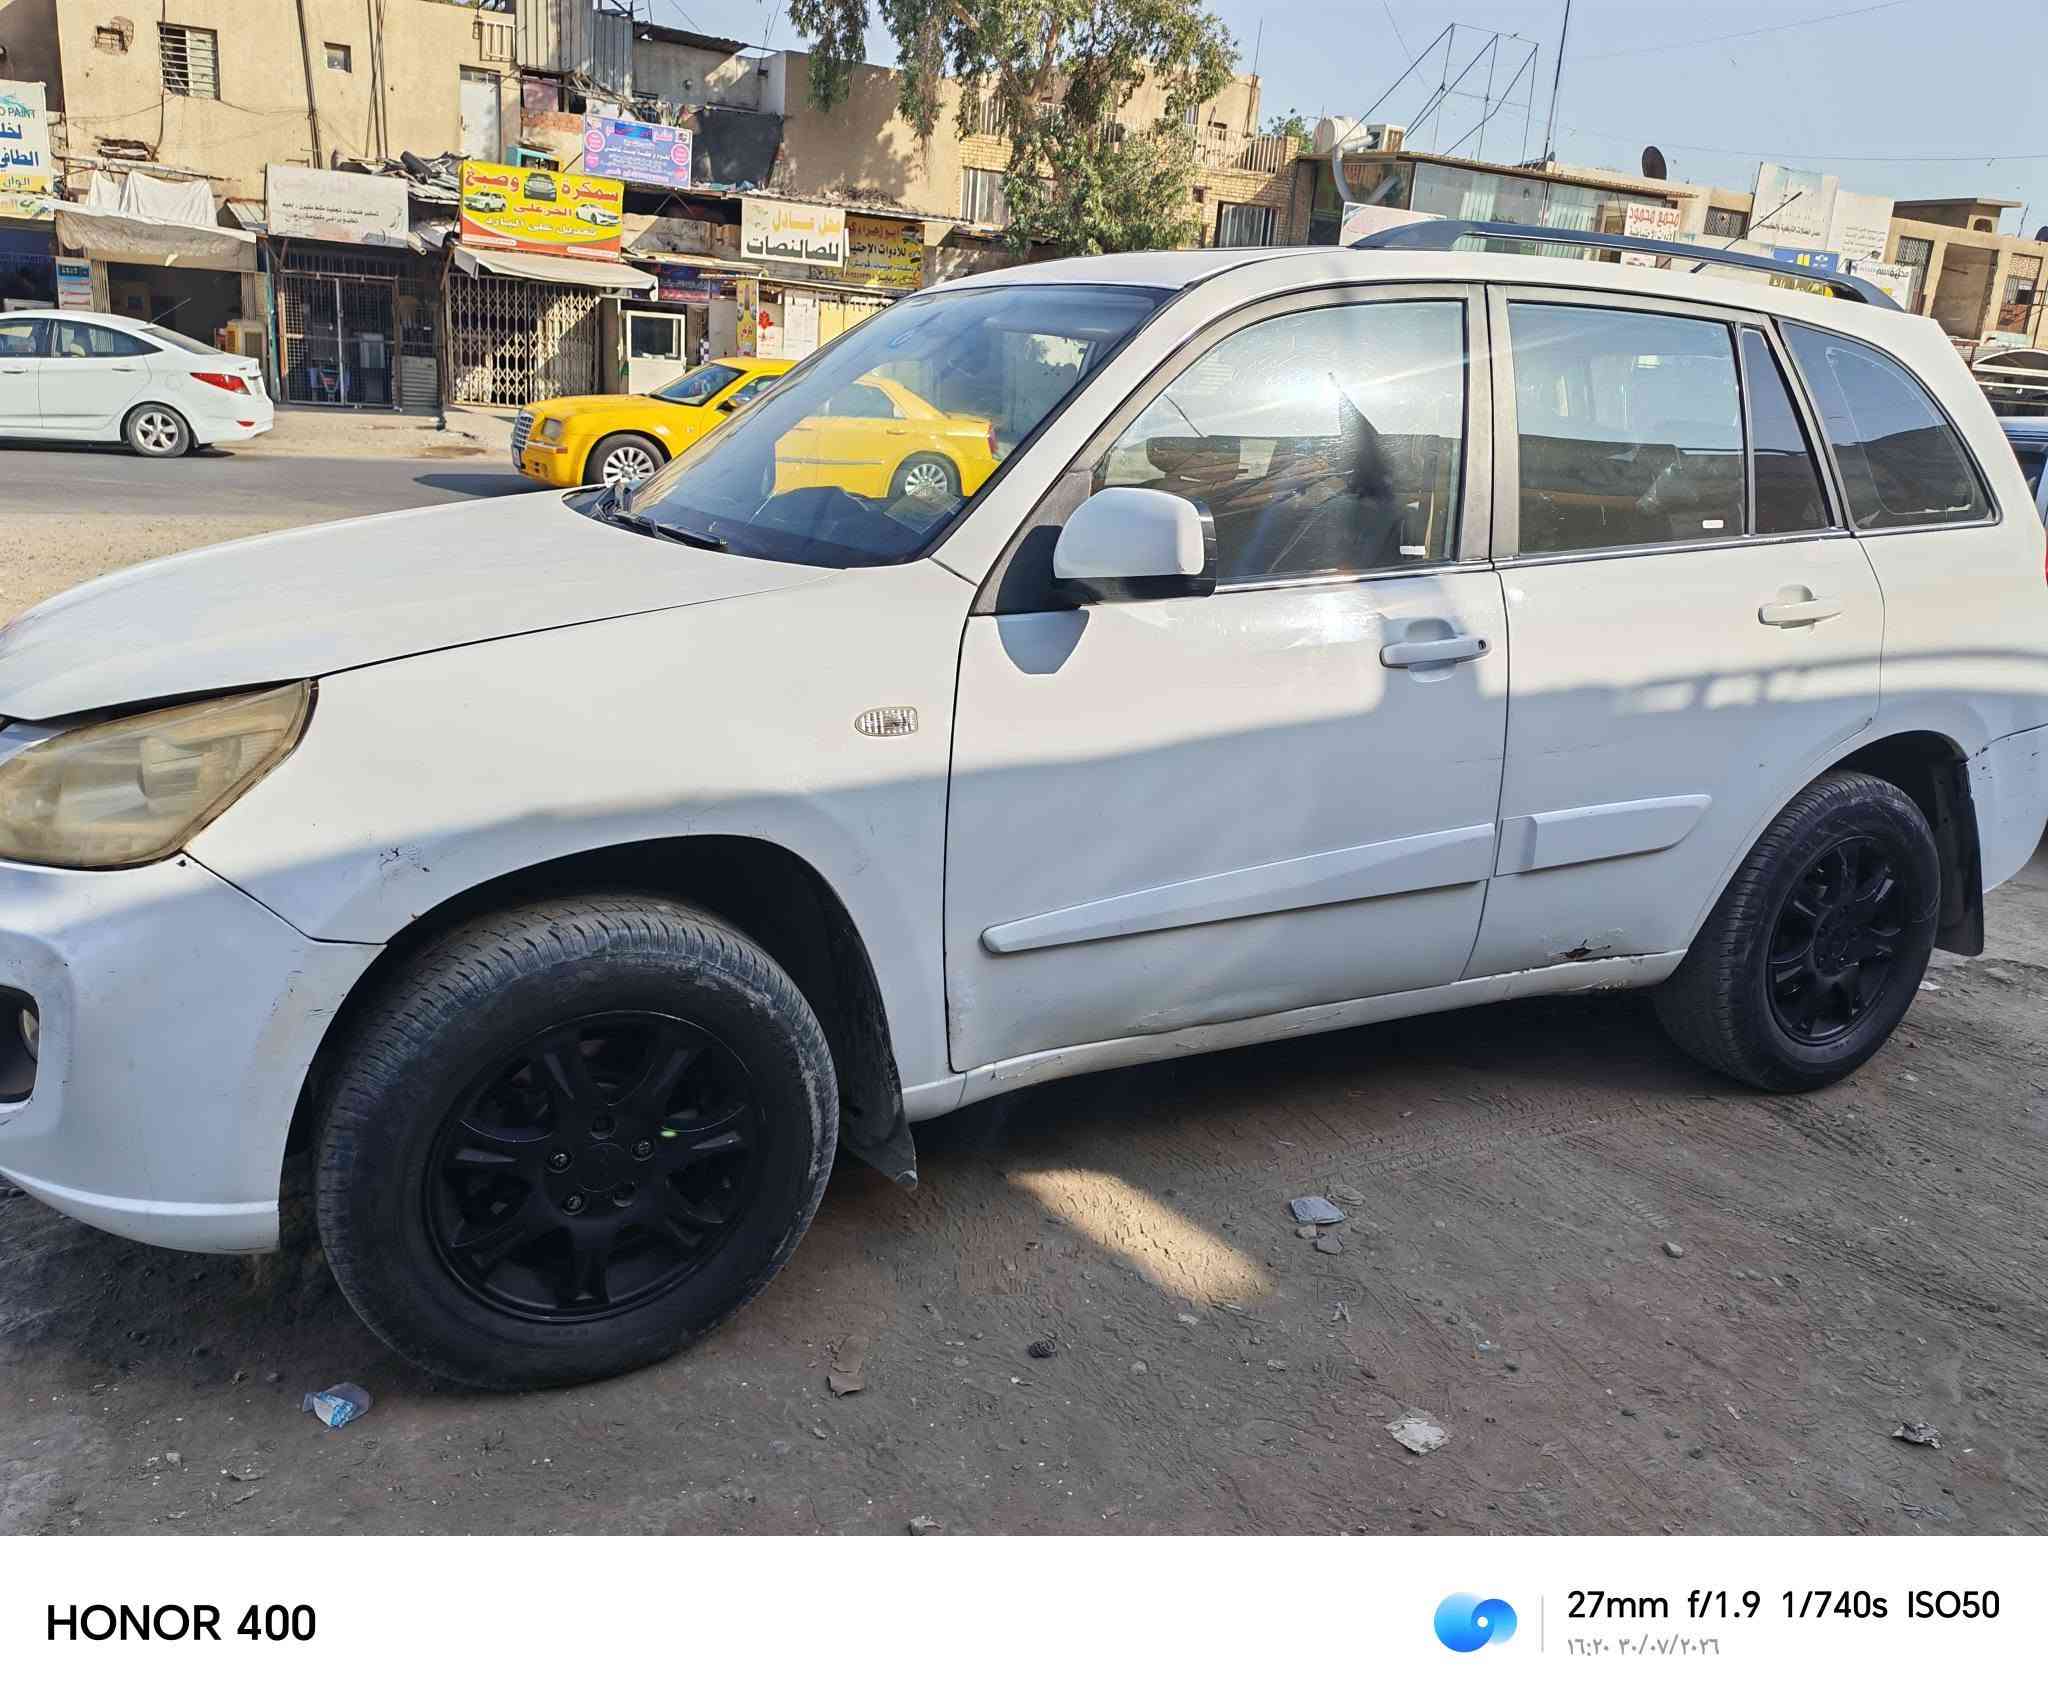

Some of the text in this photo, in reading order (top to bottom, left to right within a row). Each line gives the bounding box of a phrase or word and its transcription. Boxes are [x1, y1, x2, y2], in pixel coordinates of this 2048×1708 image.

[464, 166, 618, 202] سمكرة وصبغ
[746, 234, 839, 262] للصالنصات
